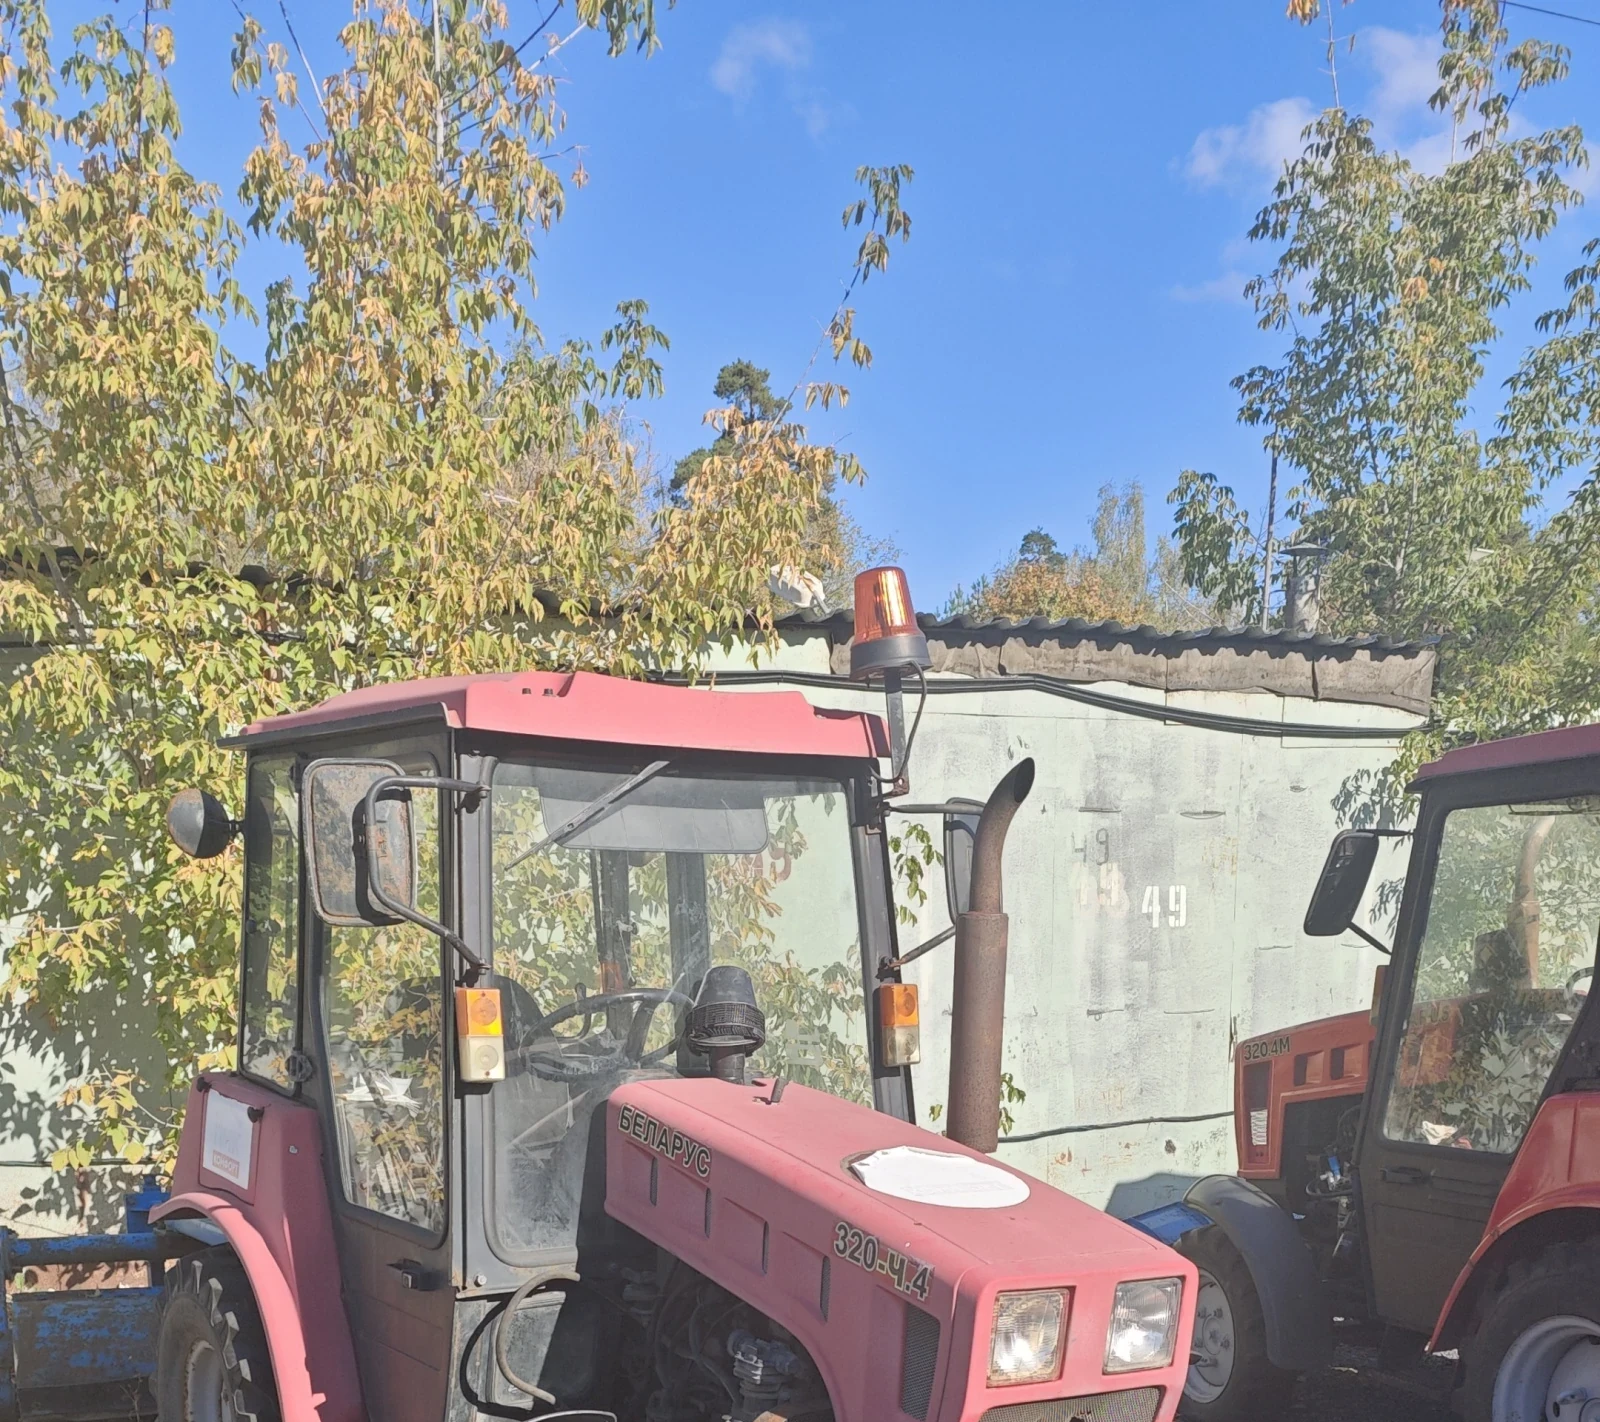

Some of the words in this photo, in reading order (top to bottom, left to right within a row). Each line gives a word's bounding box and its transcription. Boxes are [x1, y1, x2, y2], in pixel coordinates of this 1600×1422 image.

[1141, 885, 1187, 928] 49
[1244, 1036, 1290, 1060] 320.4M
[619, 1104, 710, 1177] БЕЛАРУС
[834, 1222, 929, 1301] 320-Ч.4
